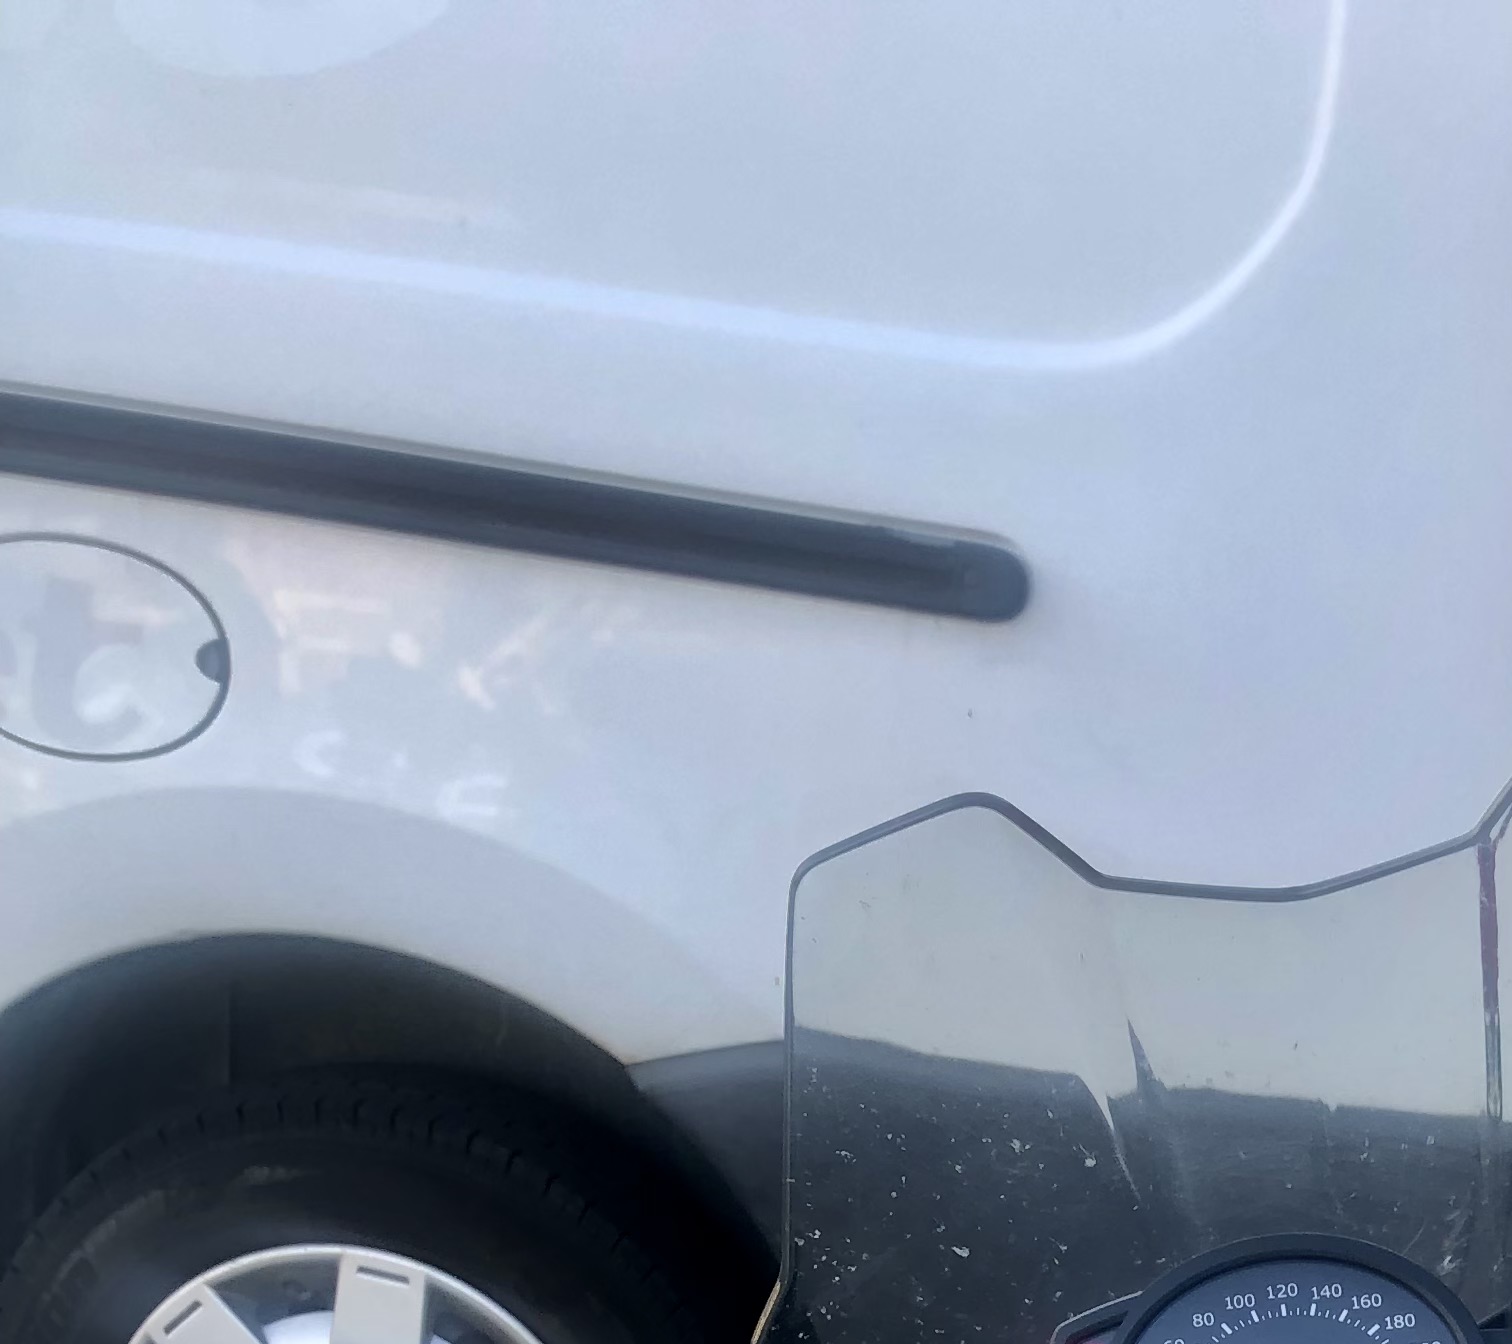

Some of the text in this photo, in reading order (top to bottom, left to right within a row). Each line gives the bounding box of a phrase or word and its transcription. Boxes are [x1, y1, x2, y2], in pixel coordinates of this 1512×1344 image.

[1267, 1283, 1298, 1299] 120
[1311, 1283, 1342, 1300] 140
[1224, 1293, 1256, 1310] 100
[1351, 1293, 1382, 1310] 160
[1192, 1312, 1215, 1328] 80
[1384, 1313, 1416, 1330] 180
